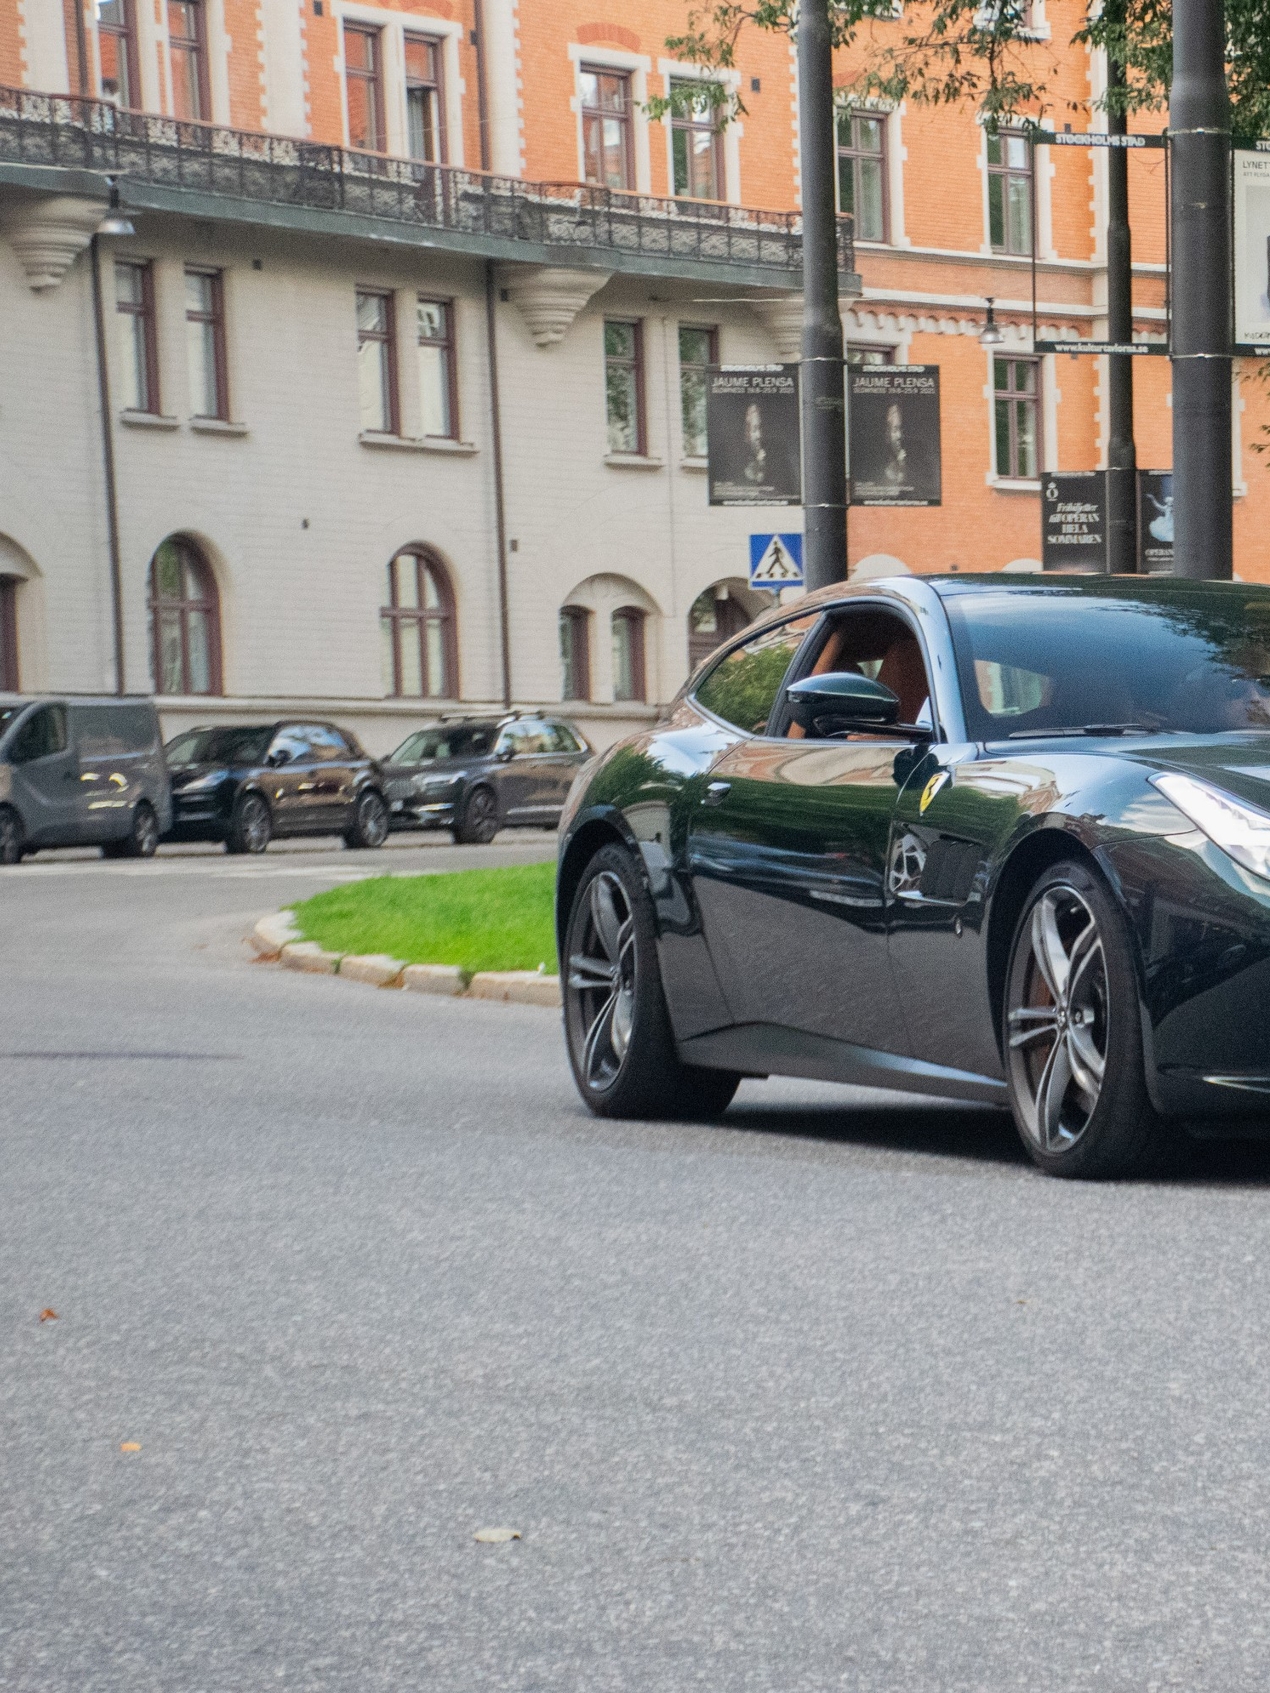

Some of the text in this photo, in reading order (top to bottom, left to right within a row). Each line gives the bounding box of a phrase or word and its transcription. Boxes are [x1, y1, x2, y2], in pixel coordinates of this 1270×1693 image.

[1055, 133, 1146, 146] STOCKHOLMS STAD
[711, 377, 795, 387] JAUME PLENSA
[852, 377, 935, 388] JAUME PLENSA
[1062, 513, 1100, 523] OPERAN
[1062, 524, 1089, 534] HELA
[1047, 534, 1102, 545] SOMMAREN
